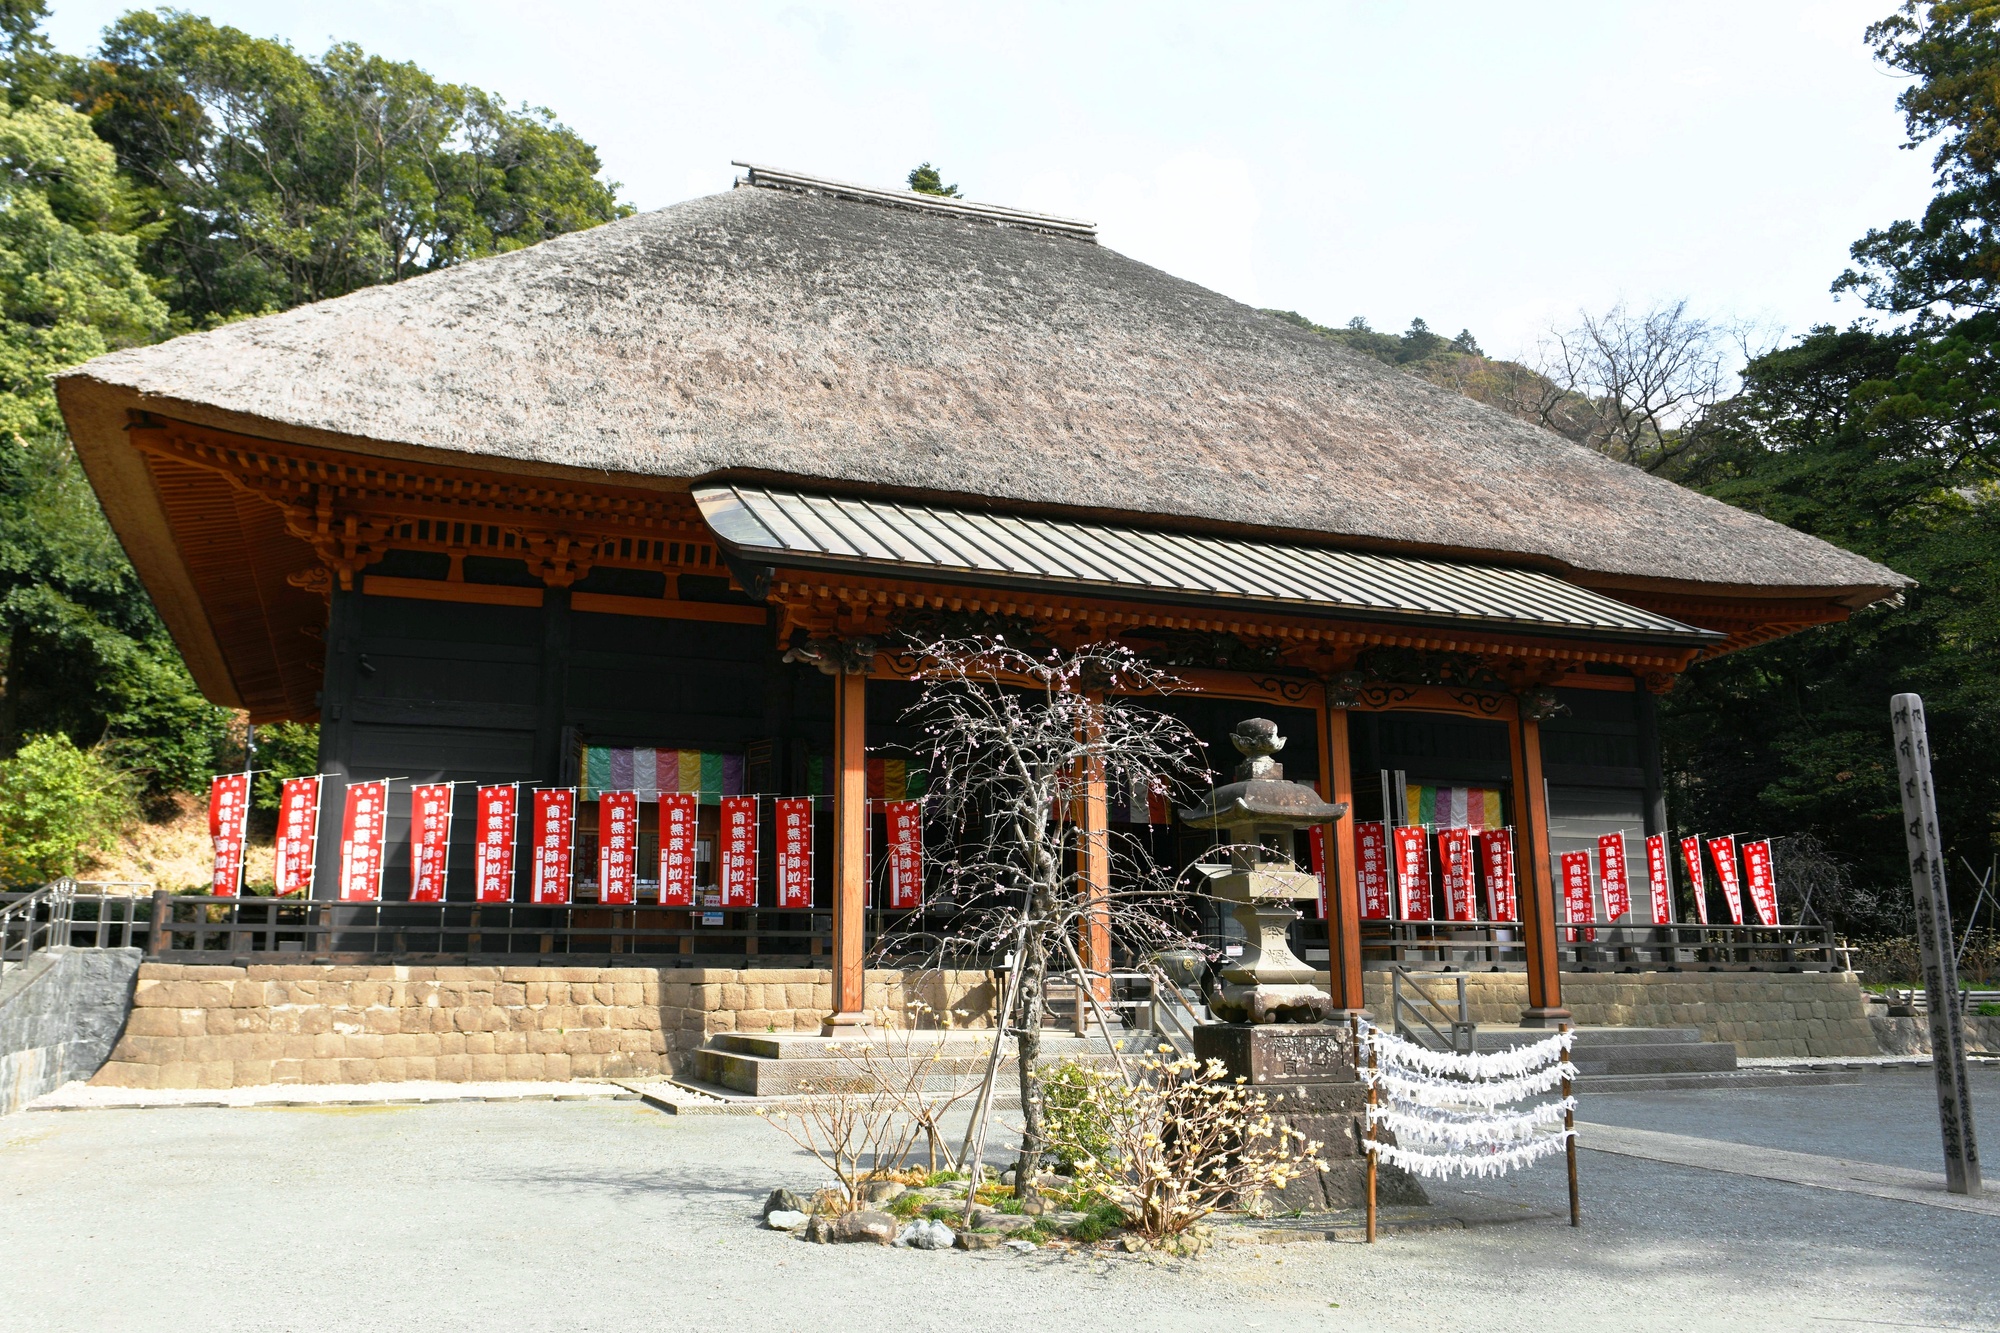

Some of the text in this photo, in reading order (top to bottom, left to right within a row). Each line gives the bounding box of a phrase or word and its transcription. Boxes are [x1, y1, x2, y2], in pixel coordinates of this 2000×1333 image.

[220, 780, 239, 790] 奉納
[290, 783, 310, 792] 奉納
[354, 788, 377, 796] 奉納
[420, 789, 443, 798] 奉納
[486, 790, 508, 798] 奉納
[542, 793, 565, 801] 奉納
[607, 795, 630, 803] 奉納
[666, 797, 688, 805] 奉納
[728, 800, 750, 808] 奉納
[783, 802, 804, 810] 奉納
[286, 794, 304, 887] 南無薬師如来
[351, 798, 372, 890] 南無薬師如来
[419, 801, 438, 890] 南無薬師如来
[485, 801, 503, 891] 南無薬師如来
[543, 804, 560, 893] 南無薬師如来
[610, 806, 625, 894] 南無薬師如来
[668, 808, 684, 896] 南無薬師如来
[730, 811, 746, 897] 南無薬師如来
[787, 812, 801, 898] 南無薬師如来
[897, 816, 912, 897] 南無薬師如来
[1358, 826, 1377, 834] 奉納
[1444, 831, 1463, 839] 奉納
[1602, 837, 1617, 845] 奉納
[1362, 836, 1380, 910] 南無薬師如来
[1405, 840, 1421, 912] 南無薬師如来
[1449, 841, 1466, 912] 南無薬師如来
[1490, 842, 1505, 913] 南無薬師如来
[1570, 864, 1585, 927] 南無薬師如
[1605, 846, 1621, 915] 南無薬師如来
